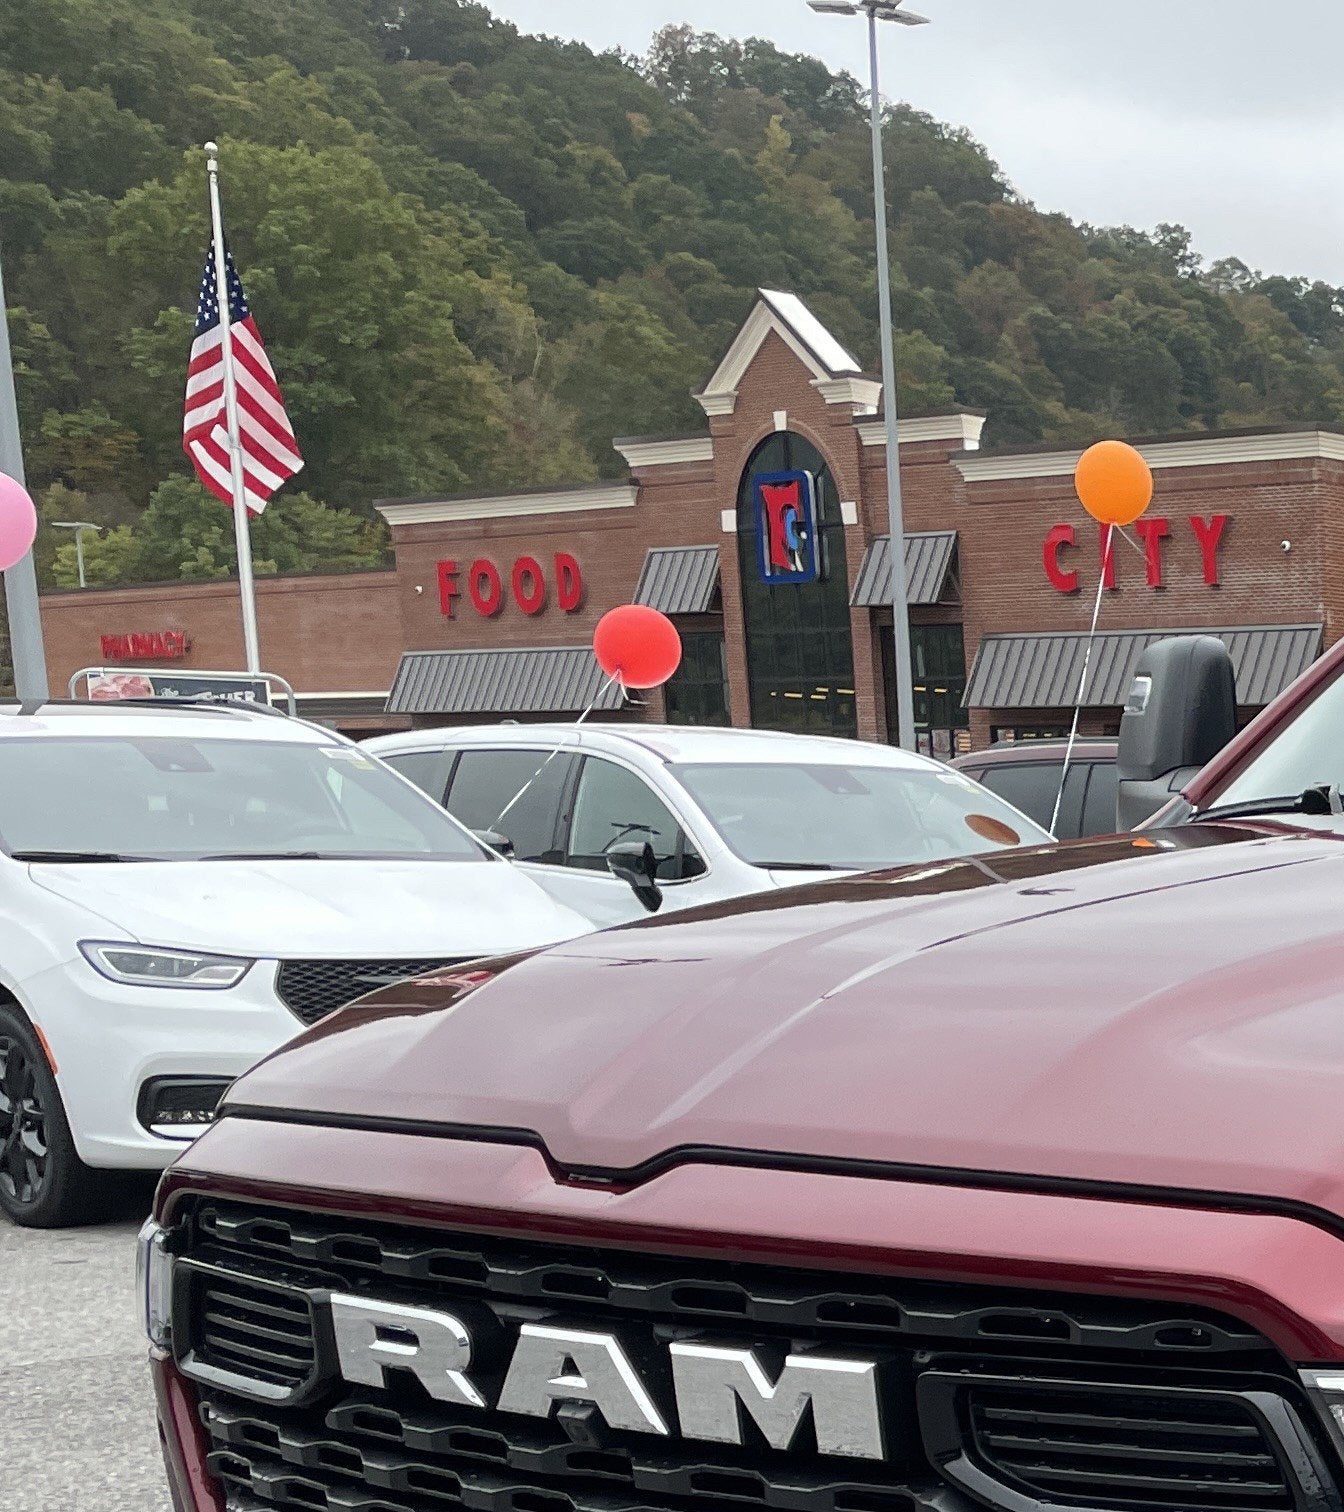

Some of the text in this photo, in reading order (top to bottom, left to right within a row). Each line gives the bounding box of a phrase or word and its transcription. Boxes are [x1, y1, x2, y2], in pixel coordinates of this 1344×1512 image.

[436, 514, 1229, 617] FOOD CITY
[330, 1292, 885, 1462] RAM
